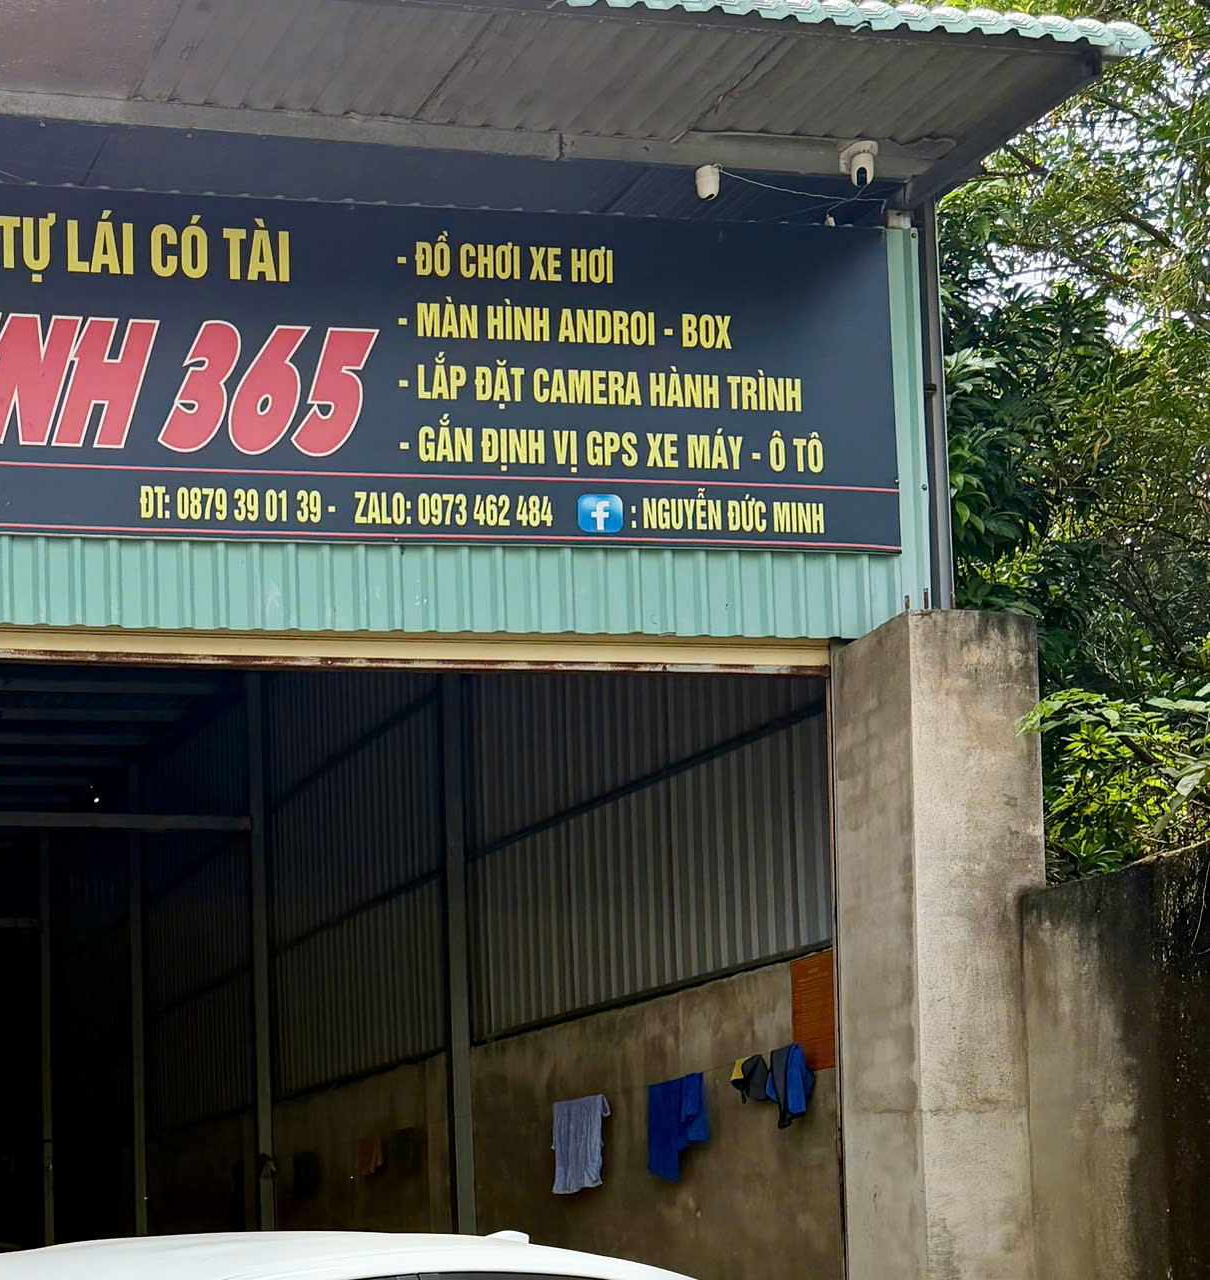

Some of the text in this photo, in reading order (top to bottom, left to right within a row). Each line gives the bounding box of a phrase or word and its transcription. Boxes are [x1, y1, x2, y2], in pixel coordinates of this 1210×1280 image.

[66, 210, 135, 276] LÁI
[150, 215, 208, 279] CÓ
[222, 218, 290, 283] TÀI
[414, 231, 451, 278] ĐỒ
[459, 242, 521, 280] CHƠI
[529, 247, 563, 282] XE
[570, 247, 614, 284] HƠI
[416, 297, 479, 340] MÀN
[486, 299, 551, 342] HÌNH
[557, 308, 655, 346] ANDROI
[681, 313, 732, 350] BOX
[157, 320, 380, 458] 365
[417, 351, 467, 401] LẮP
[474, 361, 525, 409] ĐẶT
[532, 367, 642, 406] CAMERA
[649, 372, 719, 409] HÀNH
[726, 371, 802, 413] TRÌNH
[418, 415, 474, 463] GẮN
[480, 428, 545, 472] ĐỊNH
[552, 431, 578, 474] VỊ
[586, 431, 639, 468] GPS
[646, 433, 679, 468] XE
[686, 434, 743, 471] MÁY
[769, 431, 786, 473] Ô
[792, 433, 823, 473] TÔ
[139, 487, 170, 520] ĐT:
[176, 487, 227, 521] 0879
[233, 489, 259, 522] 39
[264, 489, 287, 523] 01
[296, 490, 322, 524] 39
[354, 491, 553, 528] ZALO: 0973 462 484
[642, 487, 722, 531] NGUYỄN
[726, 500, 767, 533] ĐỨC
[772, 503, 824, 535] MINH
